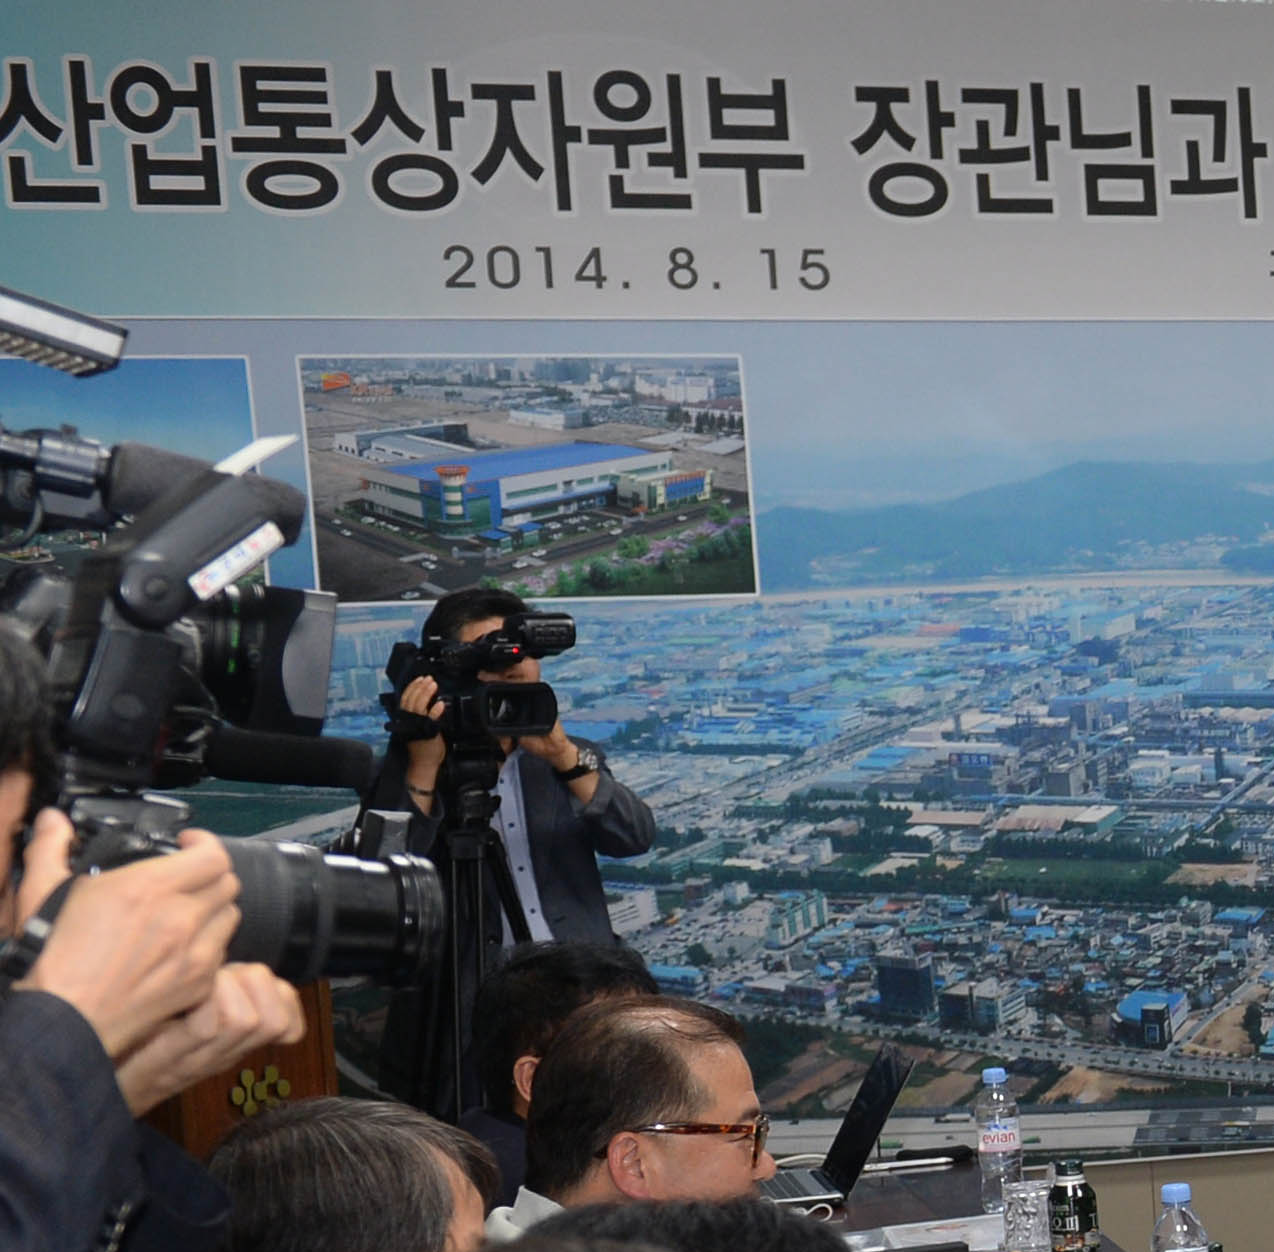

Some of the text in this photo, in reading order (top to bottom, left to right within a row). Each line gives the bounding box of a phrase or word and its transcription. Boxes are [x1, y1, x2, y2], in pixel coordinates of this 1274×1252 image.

[0, 58, 807, 215] 산업통상자원부
[850, 79, 1268, 220] 장관님과
[443, 245, 832, 292] 2014. 8. 15
[982, 1130, 1016, 1145] evian
